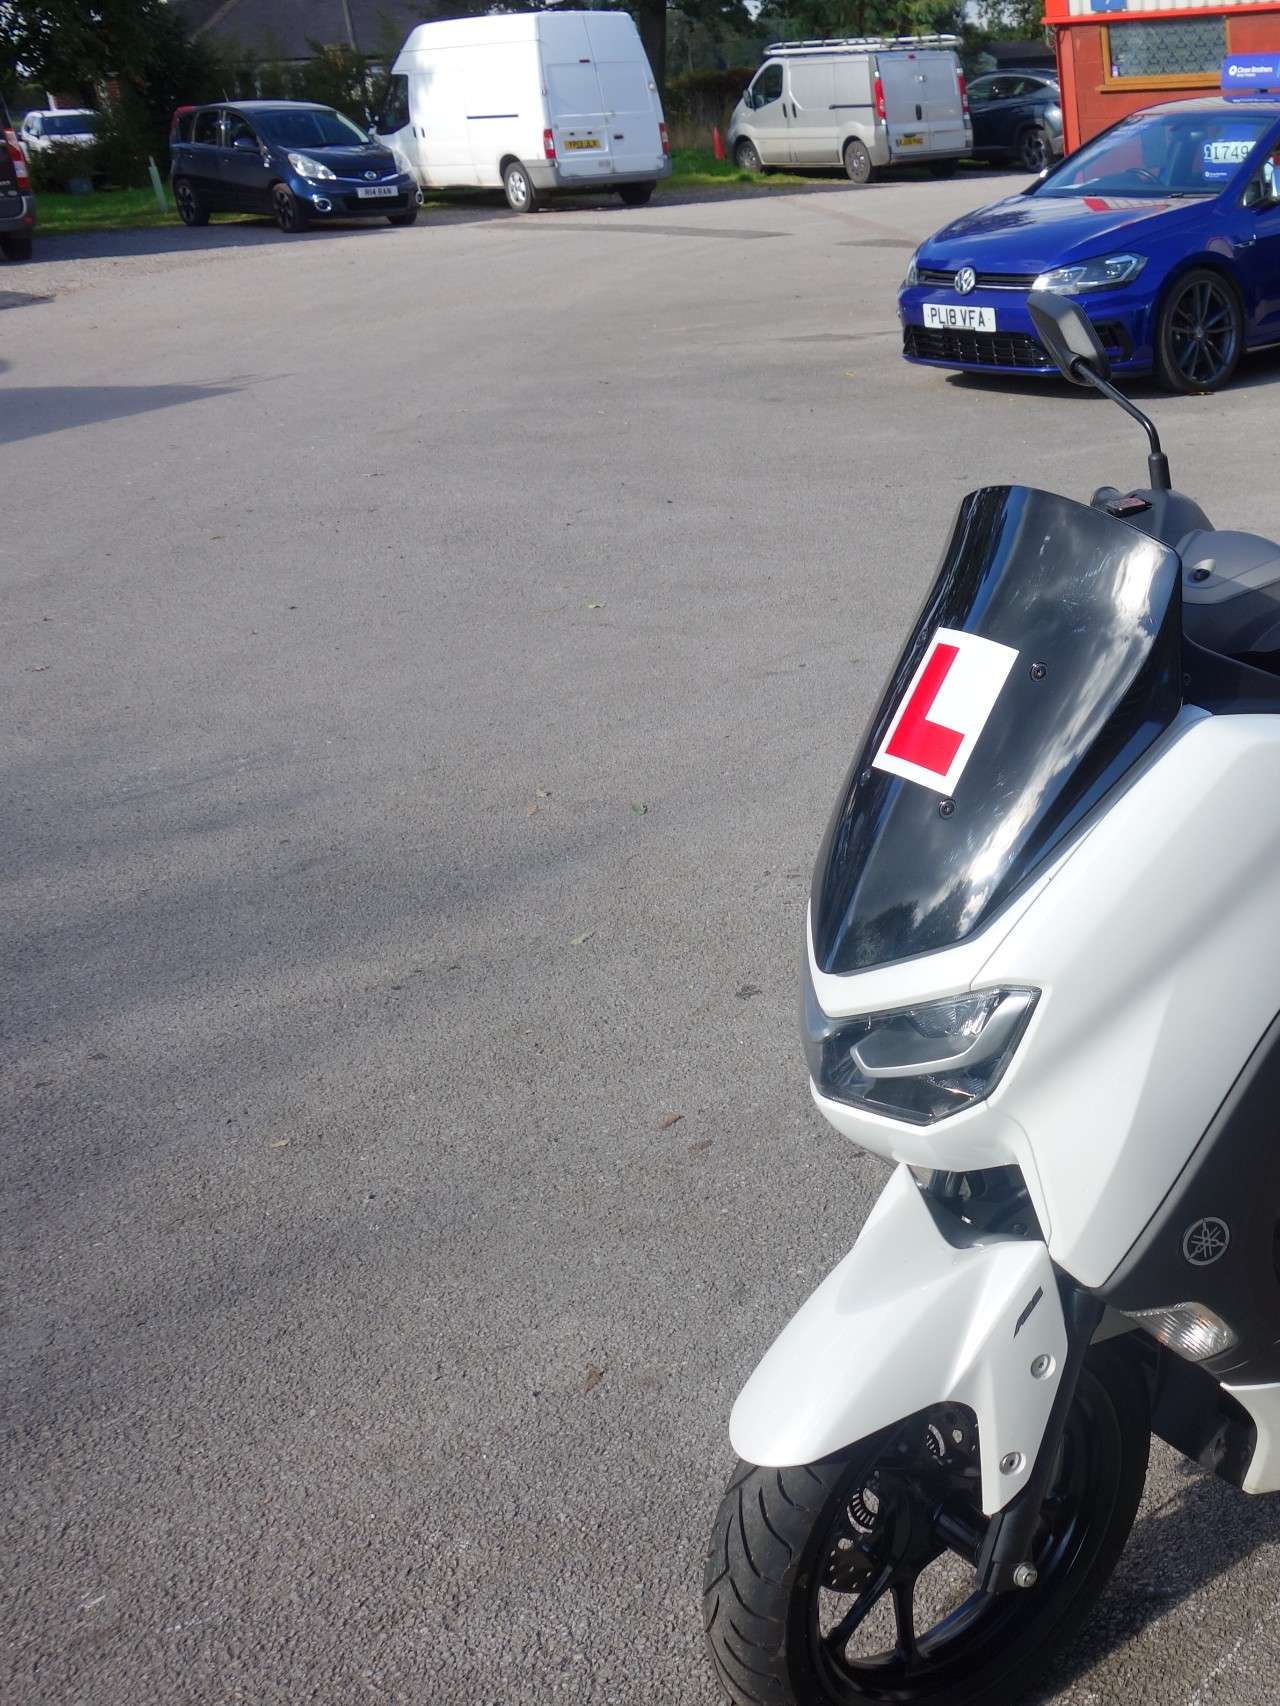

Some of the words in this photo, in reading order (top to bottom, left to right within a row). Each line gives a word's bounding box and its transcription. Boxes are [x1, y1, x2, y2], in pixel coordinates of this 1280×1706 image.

[930, 308, 957, 325] PL18
[960, 308, 986, 327] VFA
[885, 642, 965, 777] L
